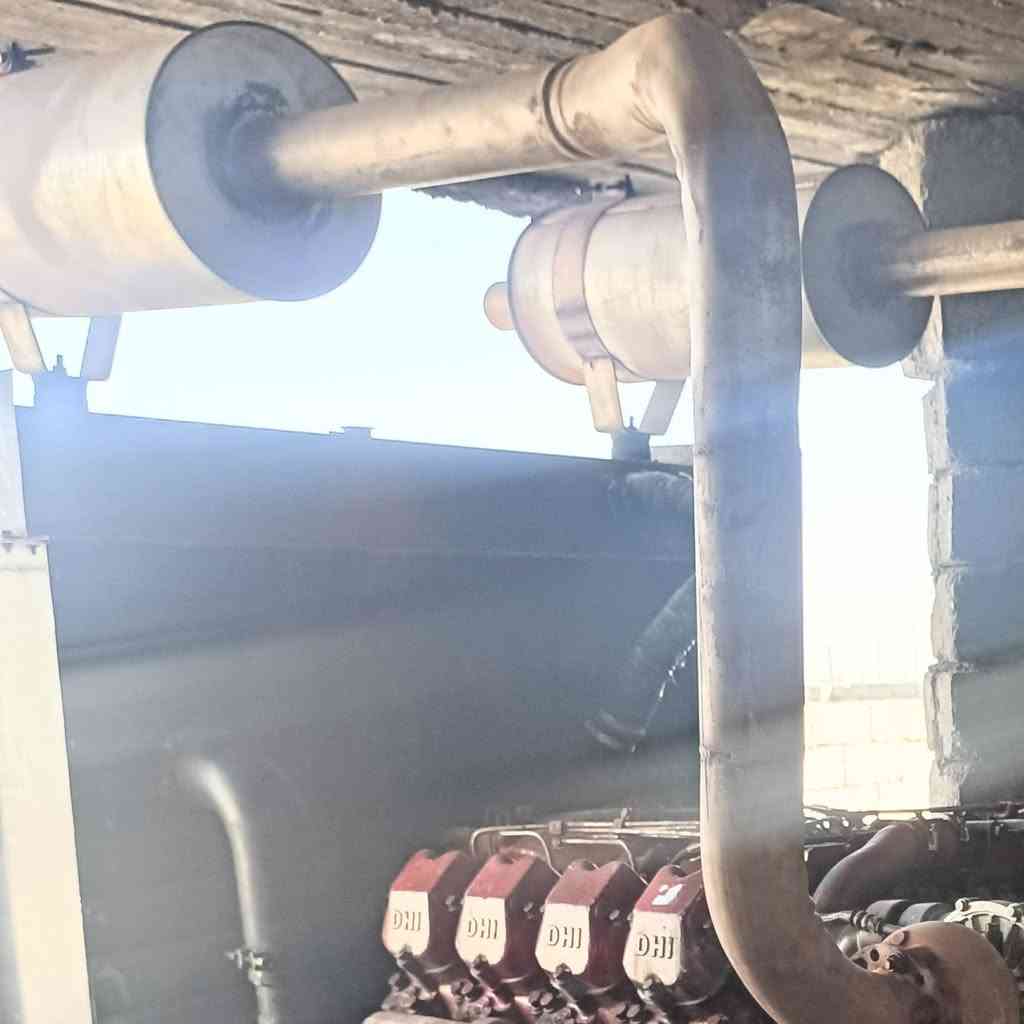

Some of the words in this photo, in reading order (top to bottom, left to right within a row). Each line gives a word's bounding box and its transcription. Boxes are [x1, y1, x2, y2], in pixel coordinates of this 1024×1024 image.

[465, 916, 499, 939] DHI
[547, 924, 583, 949] DHI
[636, 934, 676, 959] DHI
